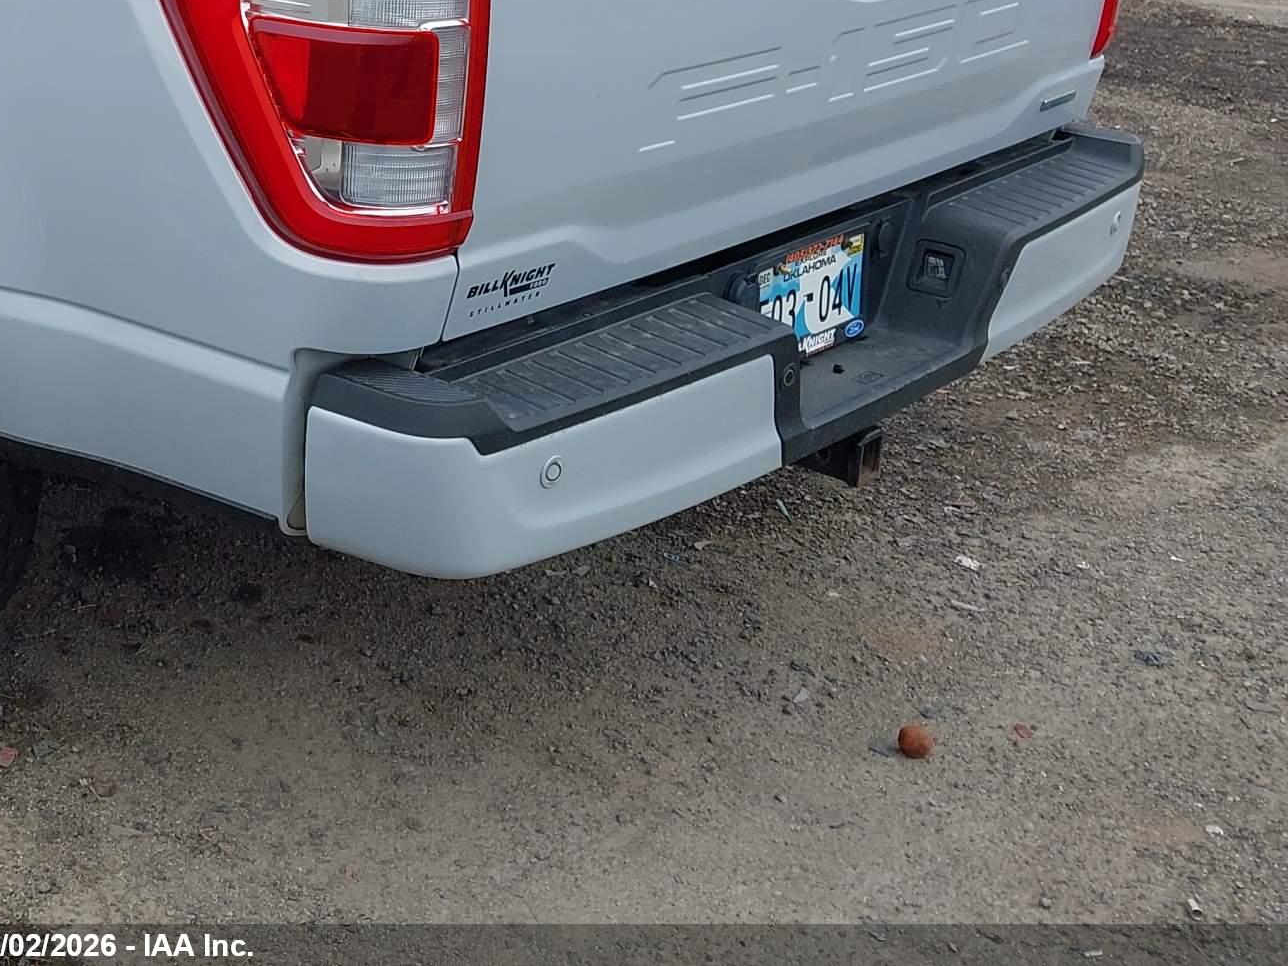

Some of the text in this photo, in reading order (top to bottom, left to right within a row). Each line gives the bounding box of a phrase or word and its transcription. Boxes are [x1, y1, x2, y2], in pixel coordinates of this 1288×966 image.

[758, 273, 771, 285] DEC
[783, 254, 837, 283] OKLAHOMA
[469, 291, 542, 317] STILLWATER
